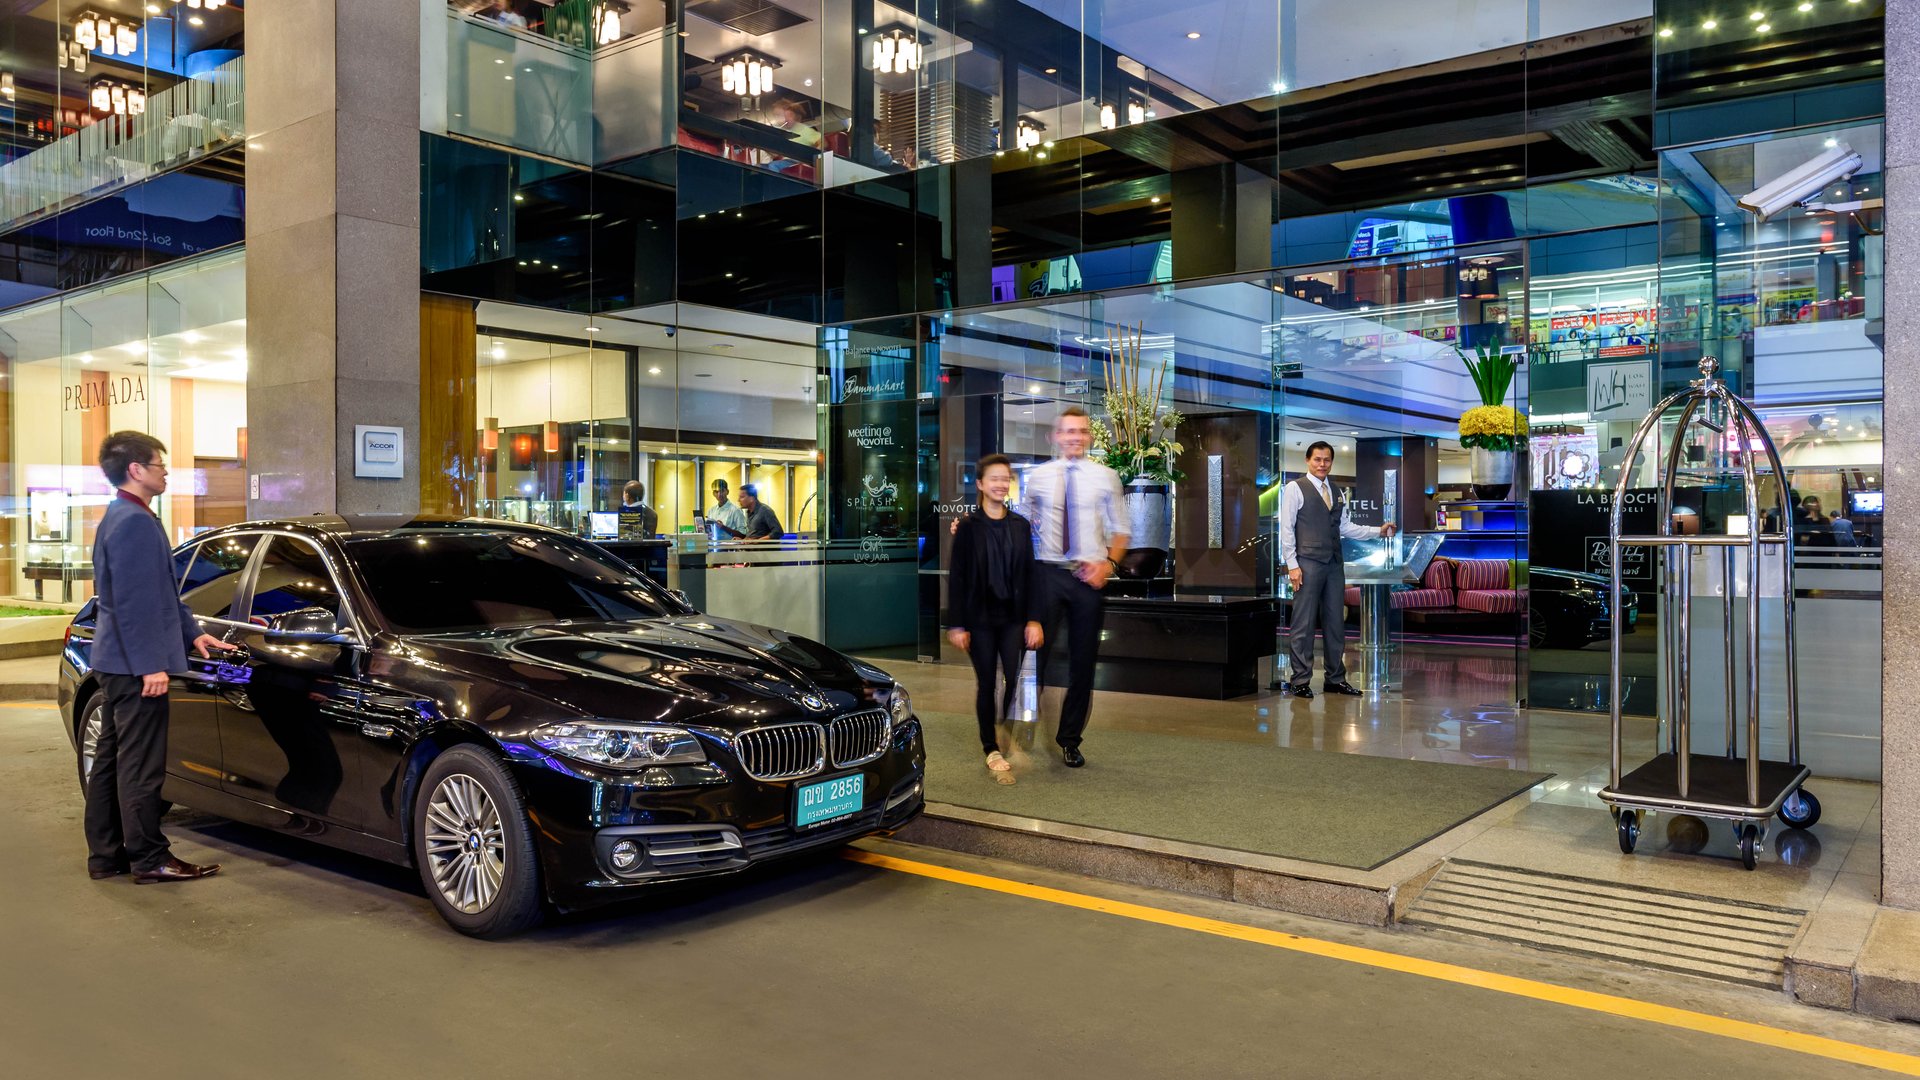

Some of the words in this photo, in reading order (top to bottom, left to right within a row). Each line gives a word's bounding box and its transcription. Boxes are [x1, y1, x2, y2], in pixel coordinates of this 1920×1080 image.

[64, 373, 145, 412] PRIMADA
[848, 426, 882, 438] Meeting
[856, 436, 894, 446] NOVOTEL
[847, 497, 891, 507] SPLASH
[1577, 494, 1594, 504] LA
[830, 777, 861, 800] 2856
